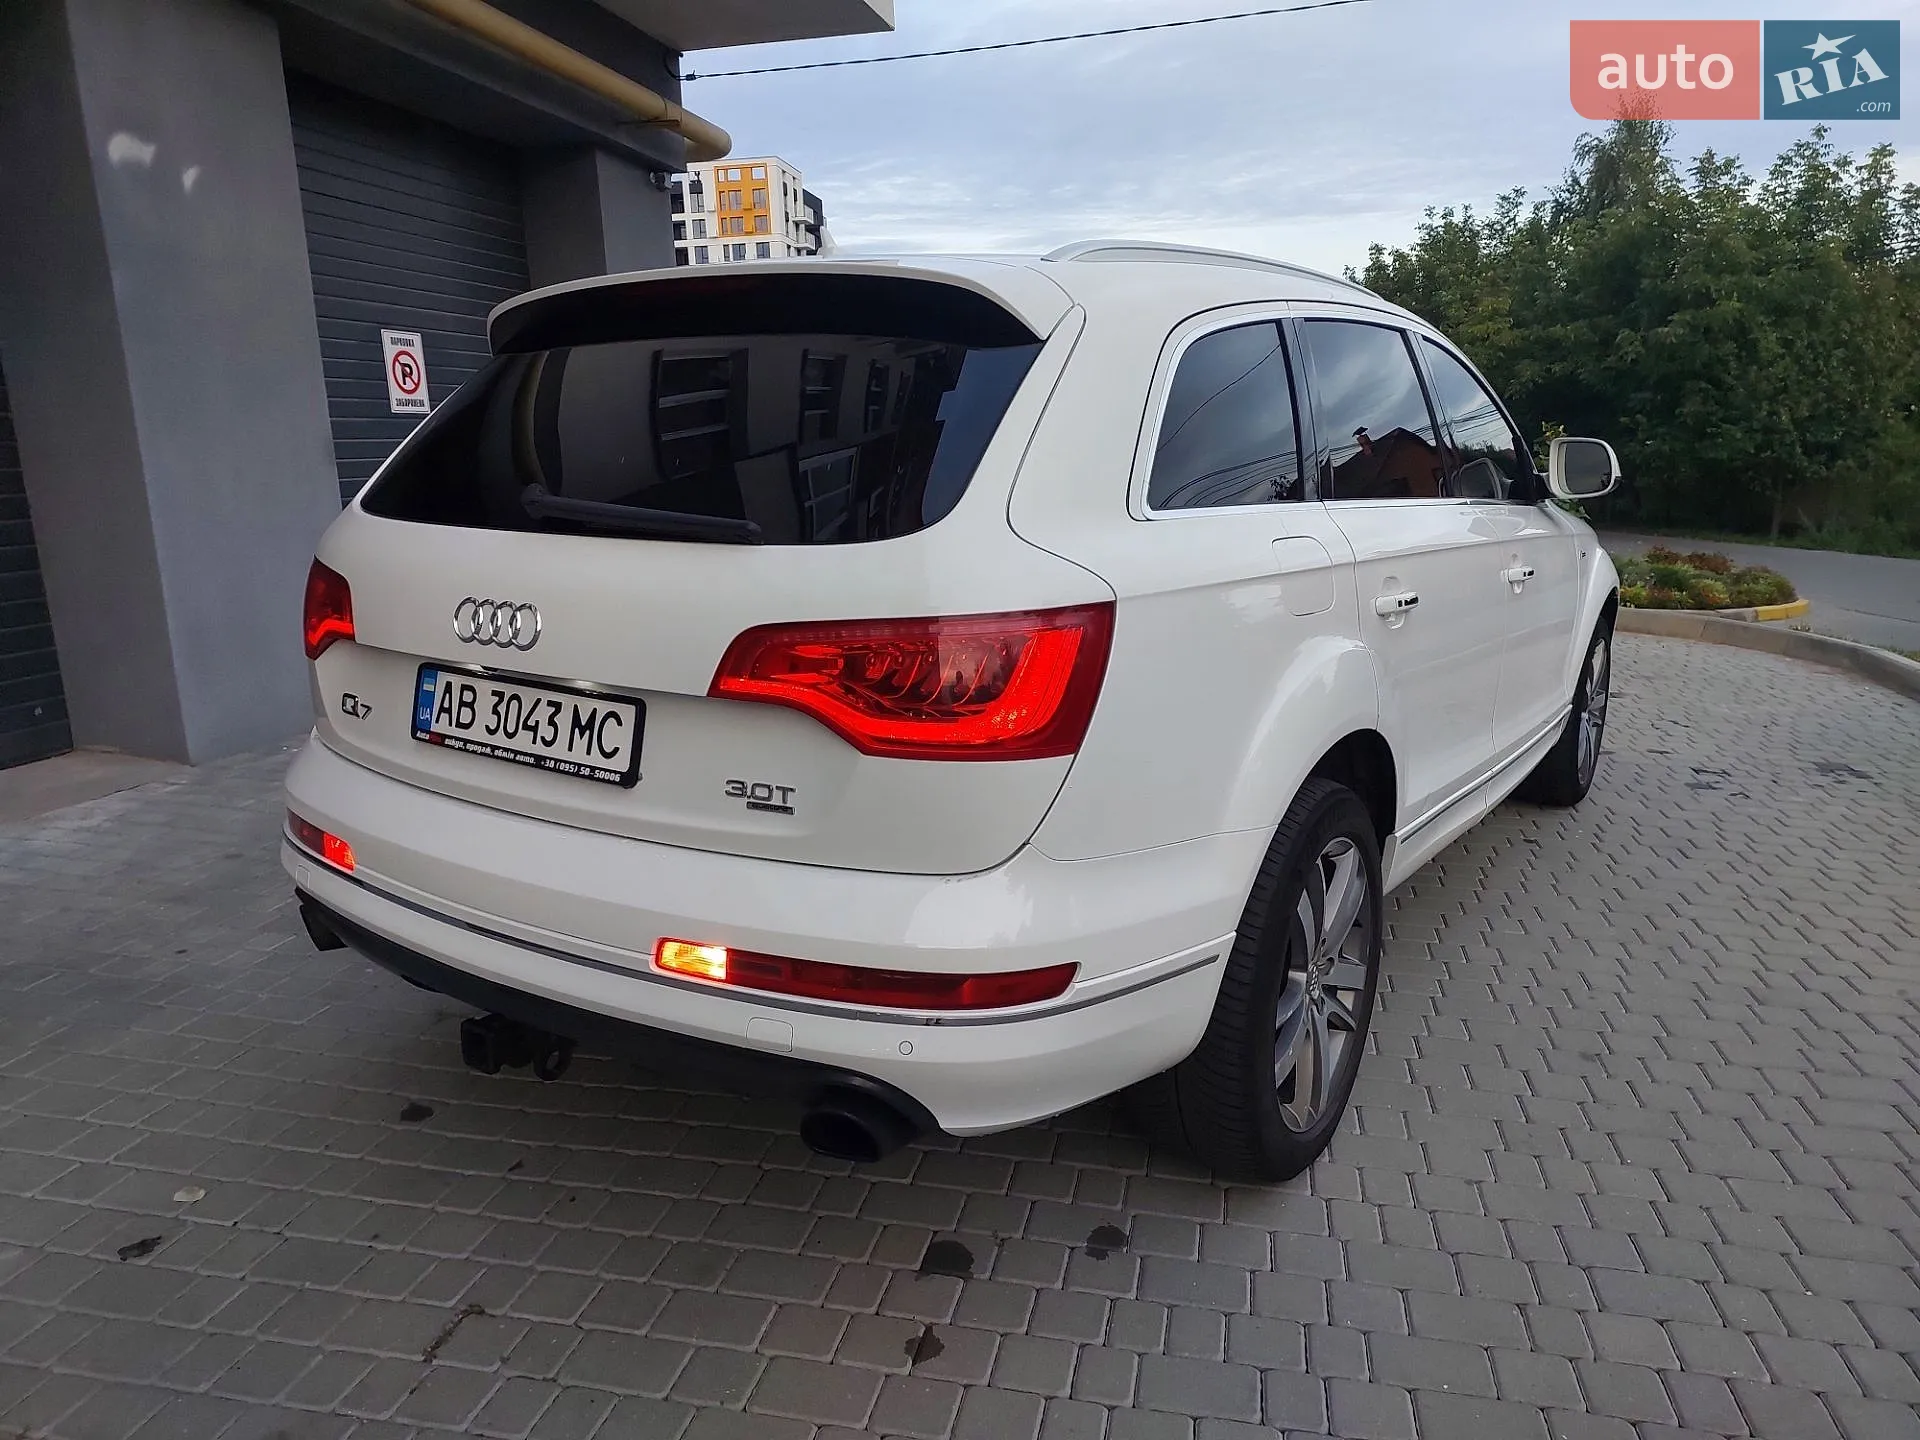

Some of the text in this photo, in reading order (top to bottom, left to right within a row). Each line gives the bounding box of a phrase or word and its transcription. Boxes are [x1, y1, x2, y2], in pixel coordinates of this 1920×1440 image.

[341, 692, 372, 720] Q7
[419, 706, 431, 721] UA
[435, 680, 623, 759] AB 3043 MC
[556, 760, 578, 773] (095)
[579, 767, 621, 782] 50-50006
